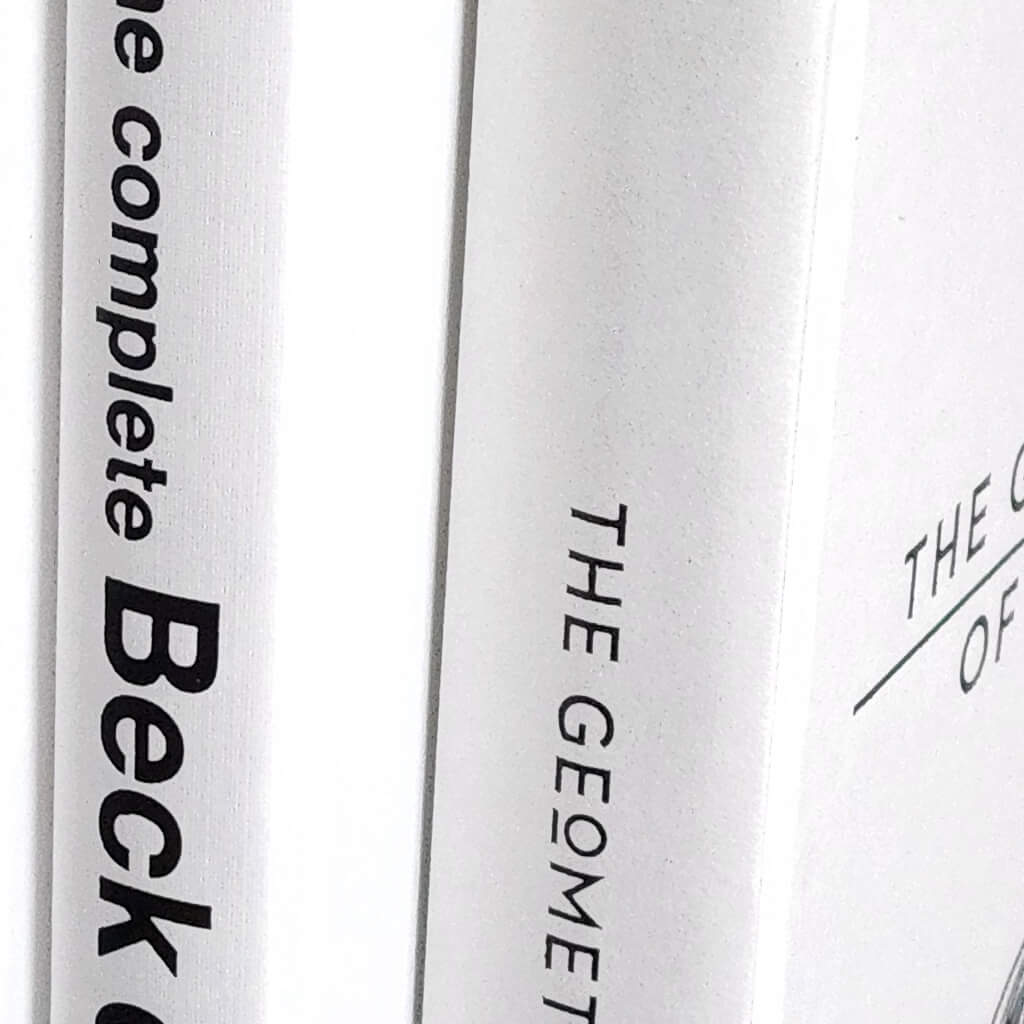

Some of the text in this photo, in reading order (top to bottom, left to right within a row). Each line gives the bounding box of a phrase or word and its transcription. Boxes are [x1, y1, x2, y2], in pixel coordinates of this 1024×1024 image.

[95, 105, 173, 541] complete
[563, 503, 628, 662] THE
[903, 473, 992, 619] THE
[959, 576, 1019, 694] OF
[97, 575, 220, 978] Beck
